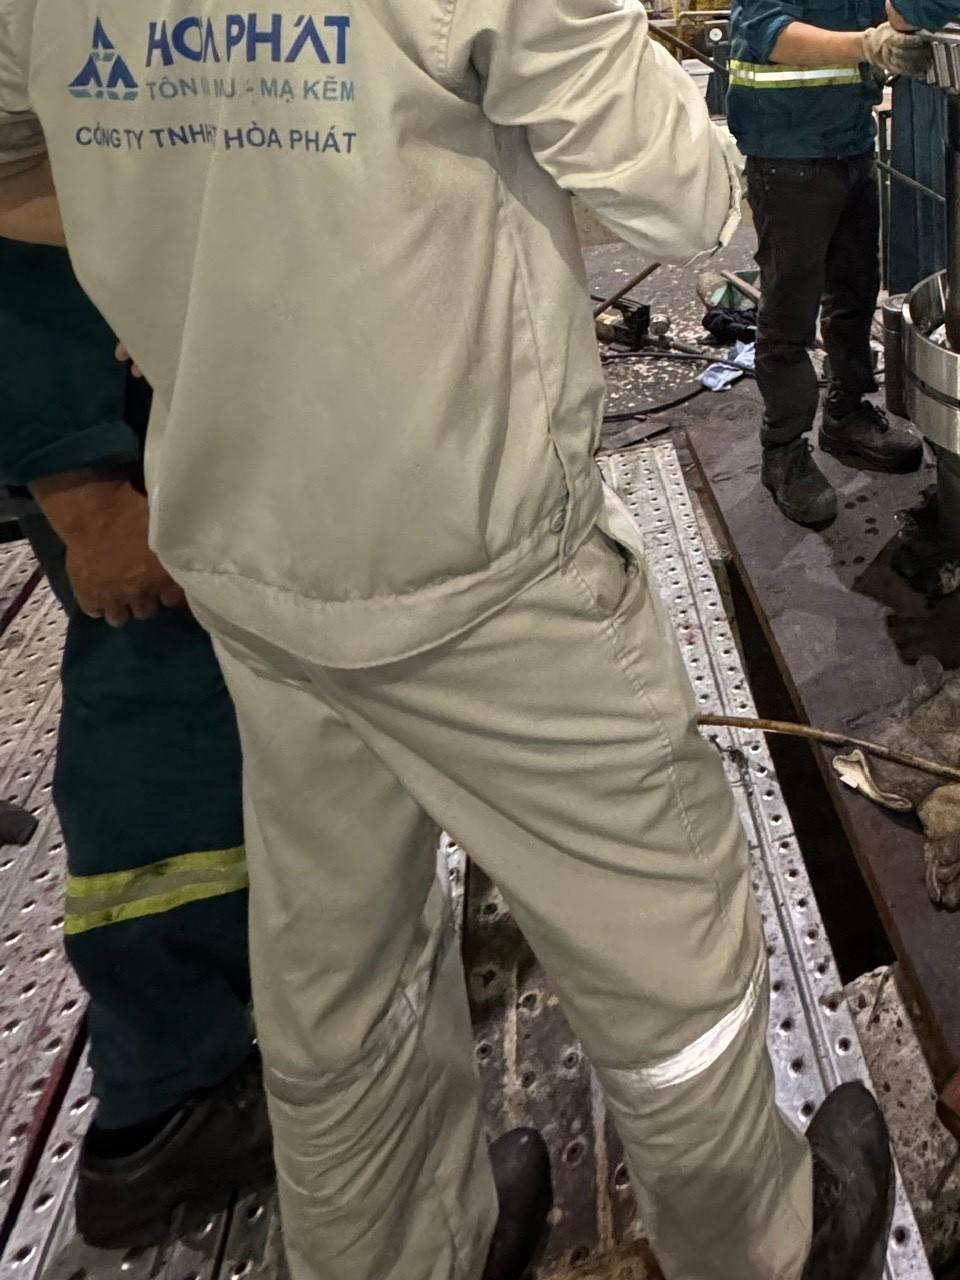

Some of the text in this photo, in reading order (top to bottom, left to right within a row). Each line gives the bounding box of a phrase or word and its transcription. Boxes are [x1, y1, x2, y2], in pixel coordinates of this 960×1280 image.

[225, 13, 350, 64] PHÁT
[146, 76, 198, 99] TÔN
[260, 78, 294, 103] MẠ
[303, 75, 355, 101] KẼM
[123, 128, 144, 150] TY
[224, 121, 283, 151] HÒA
[289, 126, 357, 154] PHÁT
